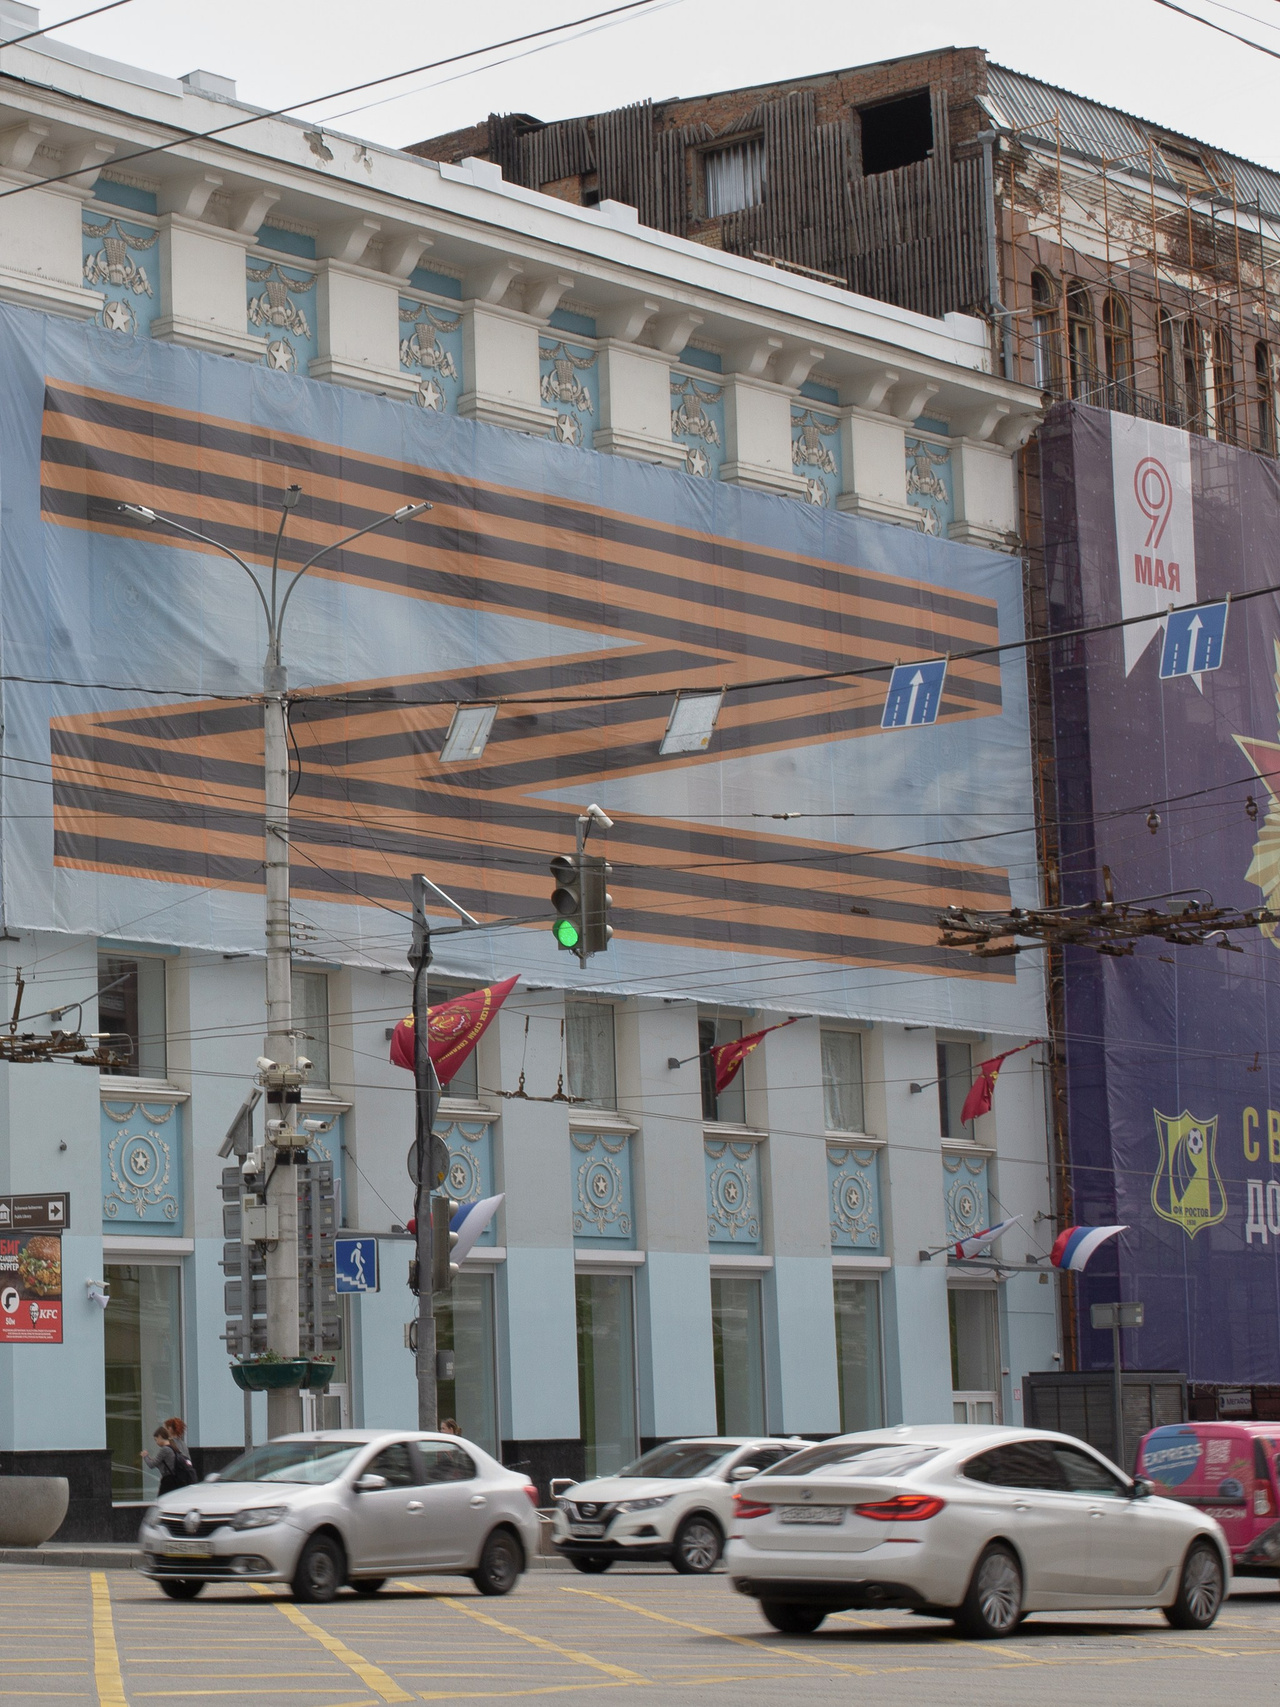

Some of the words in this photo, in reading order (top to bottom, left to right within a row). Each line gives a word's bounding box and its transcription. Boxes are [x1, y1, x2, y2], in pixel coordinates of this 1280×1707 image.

[1133, 456, 1173, 549] 9
[1134, 553, 1181, 593] МАЯ
[1173, 1205, 1183, 1214] ФК
[1184, 1207, 1209, 1217] РОСТОВ
[0, 1239, 21, 1255] БИГ
[0, 1254, 19, 1263] САНДЕРС
[0, 1262, 20, 1272] БУРГЕР
[39, 1309, 58, 1320] KFC
[1142, 1443, 1203, 1467] EXPRESS
